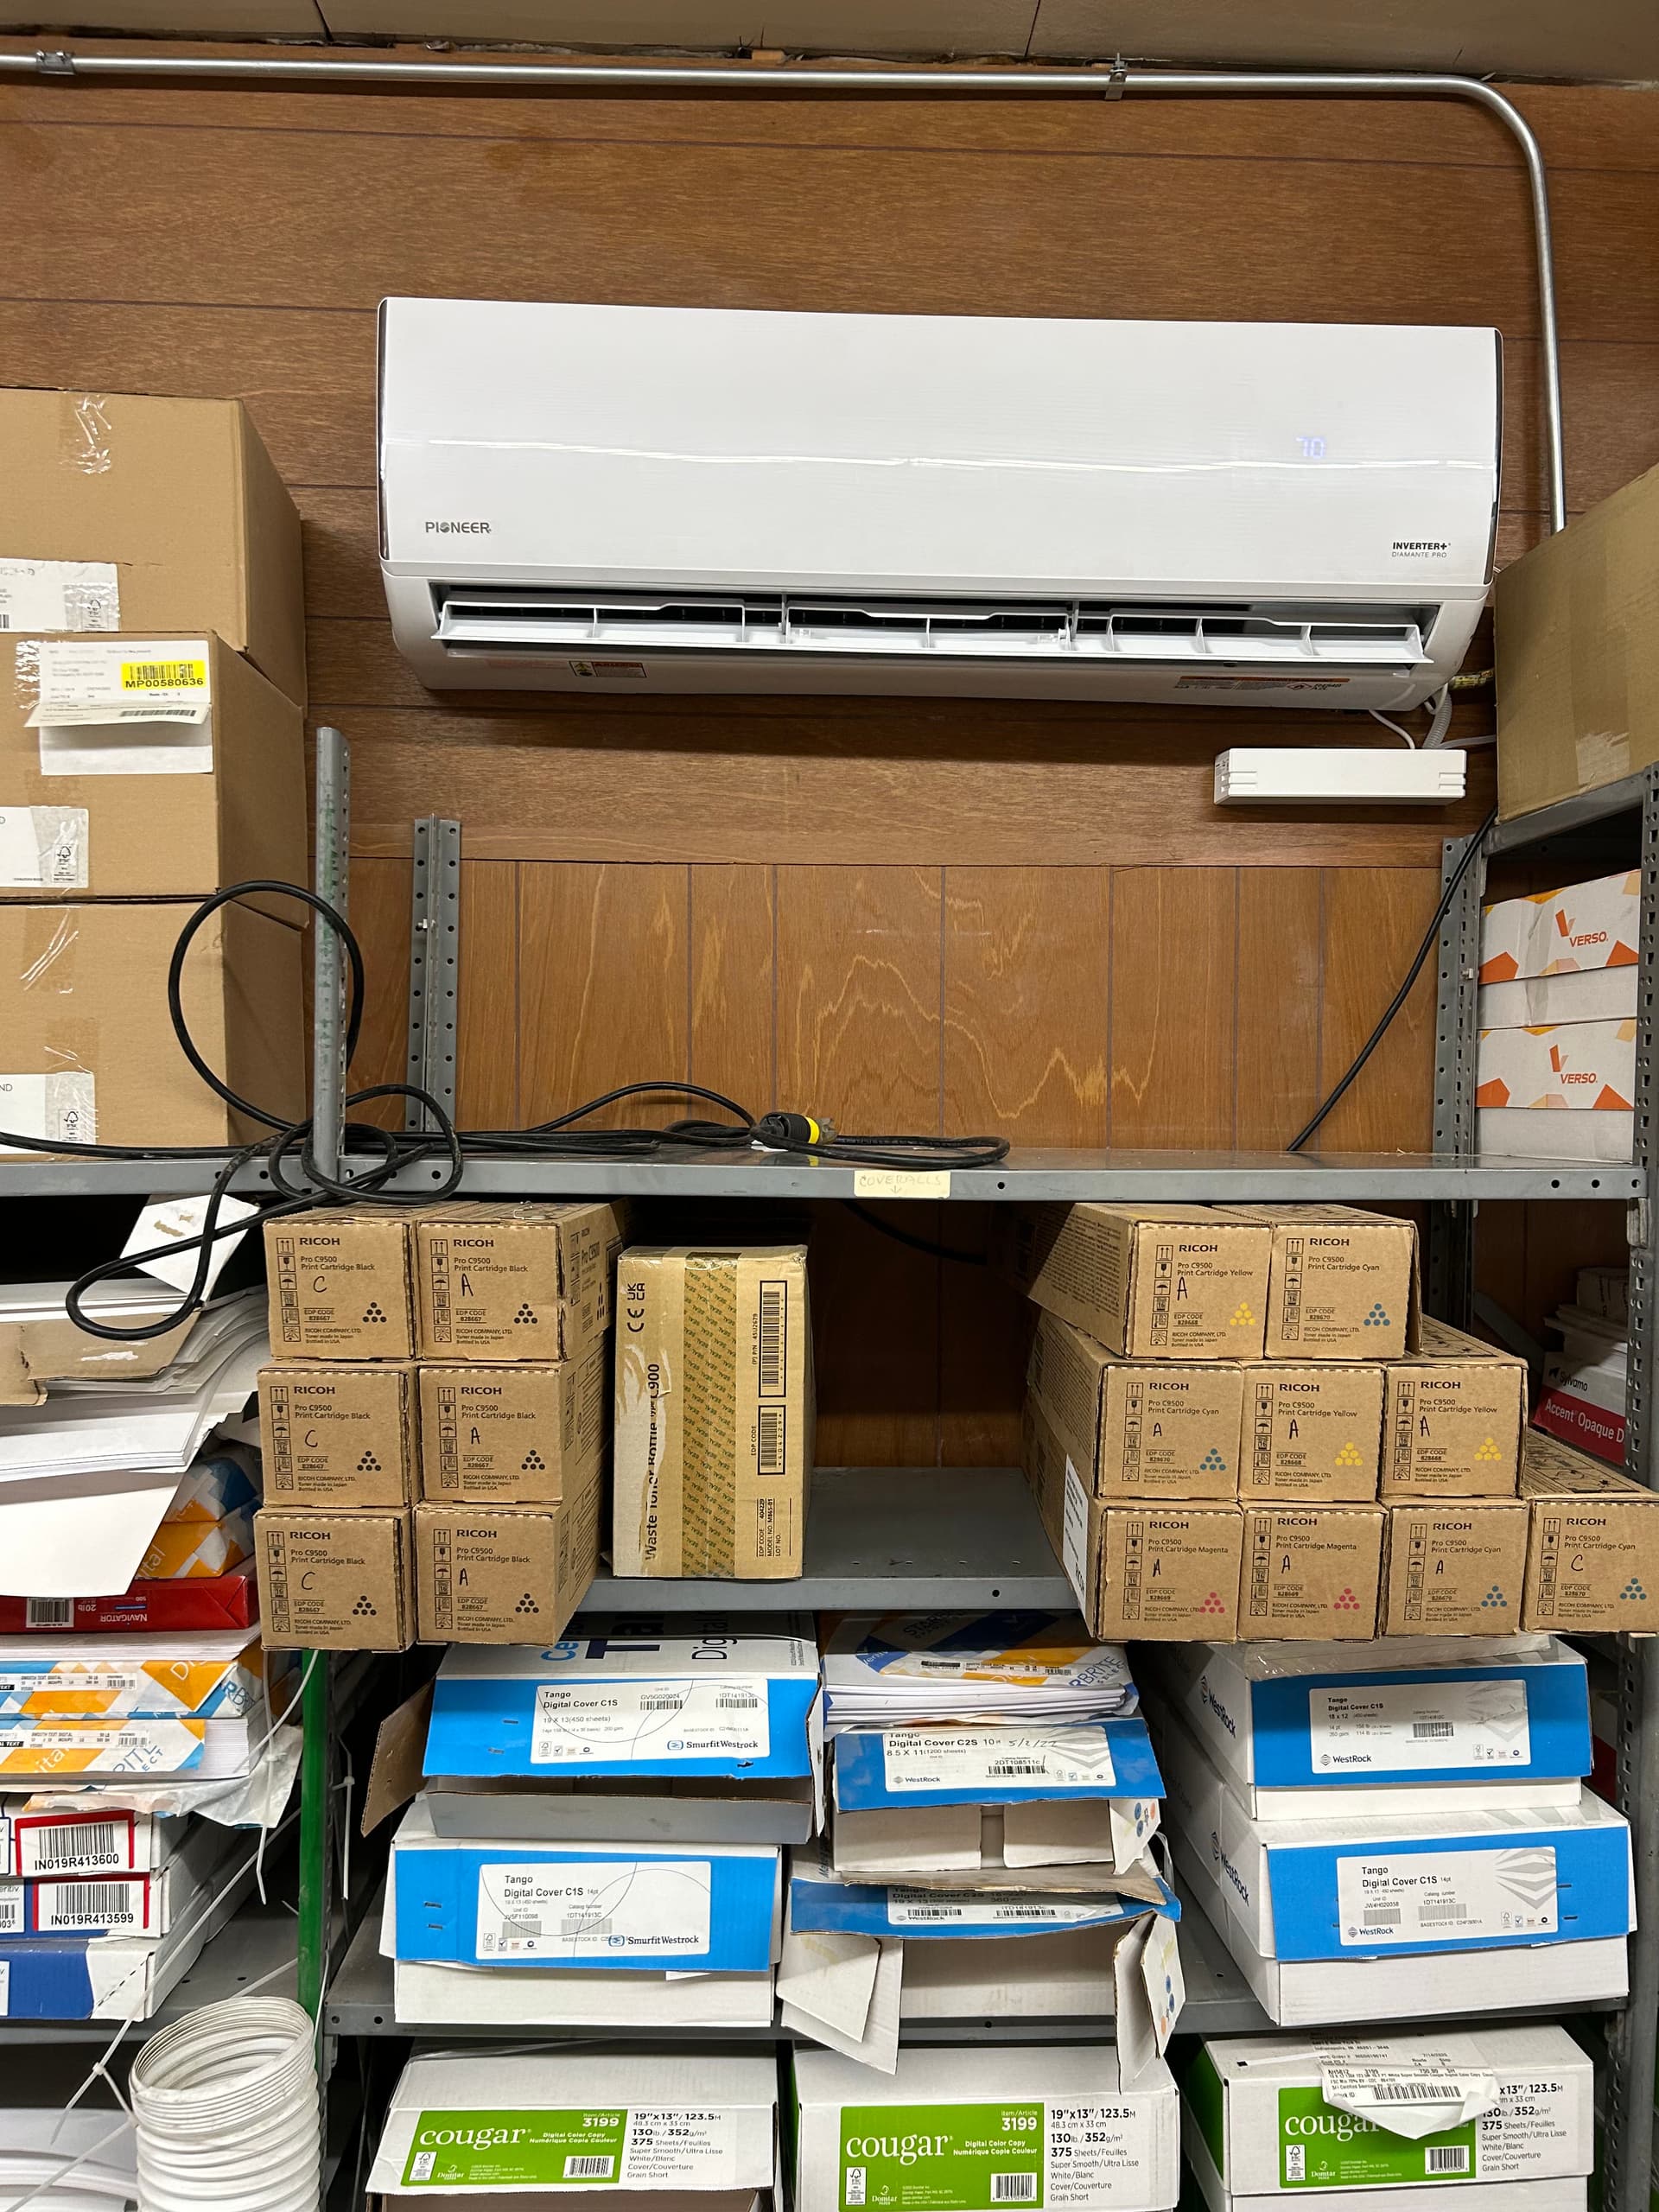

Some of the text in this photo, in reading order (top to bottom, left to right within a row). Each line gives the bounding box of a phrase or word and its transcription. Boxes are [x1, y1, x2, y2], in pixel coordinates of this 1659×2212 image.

[425, 522, 490, 533] PIONEER
[125, 678, 204, 689] MP00580636
[1569, 931, 1607, 948] VERSO
[1560, 1073, 1597, 1084] VERSO
[859, 1174, 942, 1186] COVERALLS
[313, 1276, 327, 1293] C
[462, 1274, 474, 1296] A
[1177, 1276, 1188, 1301] A
[1279, 1383, 1319, 1392] RICOH
[1421, 1381, 1461, 1389] RICOH
[1559, 1371, 1588, 1392] Sylvamo
[294, 1386, 335, 1395] RICOH
[461, 1387, 502, 1395] RICOH
[1438, 1406, 1471, 1414] Cartridge
[1154, 1422, 1162, 1437] A
[1289, 1419, 1299, 1440] A
[1578, 1412, 1614, 1440] Opaque
[305, 1429, 318, 1447] C
[470, 1427, 480, 1445] A
[1149, 1521, 1189, 1529] RICOH
[289, 1531, 331, 1540] RICOH
[456, 1529, 497, 1538] RICOH
[645, 1516, 658, 1560] Waste
[1281, 1555, 1291, 1573] A
[1435, 1560, 1444, 1574] A
[1571, 1554, 1584, 1572] C
[302, 1572, 315, 1590] C
[459, 1568, 468, 1586] A
[100, 1613, 148, 1622] NAVIGATOR
[1210, 1690, 1236, 1738] WestRock
[889, 1739, 922, 1748] Digital
[35, 1853, 119, 1871] IN019R413600
[1362, 1866, 1389, 1876] Tango
[505, 1876, 533, 1885] Tango
[1222, 1852, 1249, 1907] WestRock
[1363, 1879, 1389, 1889] Digital
[1420, 1876, 1437, 1885] C1S
[505, 1889, 533, 1898] Digital
[536, 1888, 563, 1897] Cover
[51, 1913, 134, 1925] IN019R413599
[582, 2118, 619, 2127] 3199
[1001, 2117, 1037, 2131] 3199
[1482, 2121, 1502, 2130] 375
[953, 2148, 989, 2157] Numérique
[1052, 2147, 1071, 2157] 375
[1483, 2143, 1523, 2152] White/Blanc
[1483, 2152, 1541, 2161] Cover/Couverture
